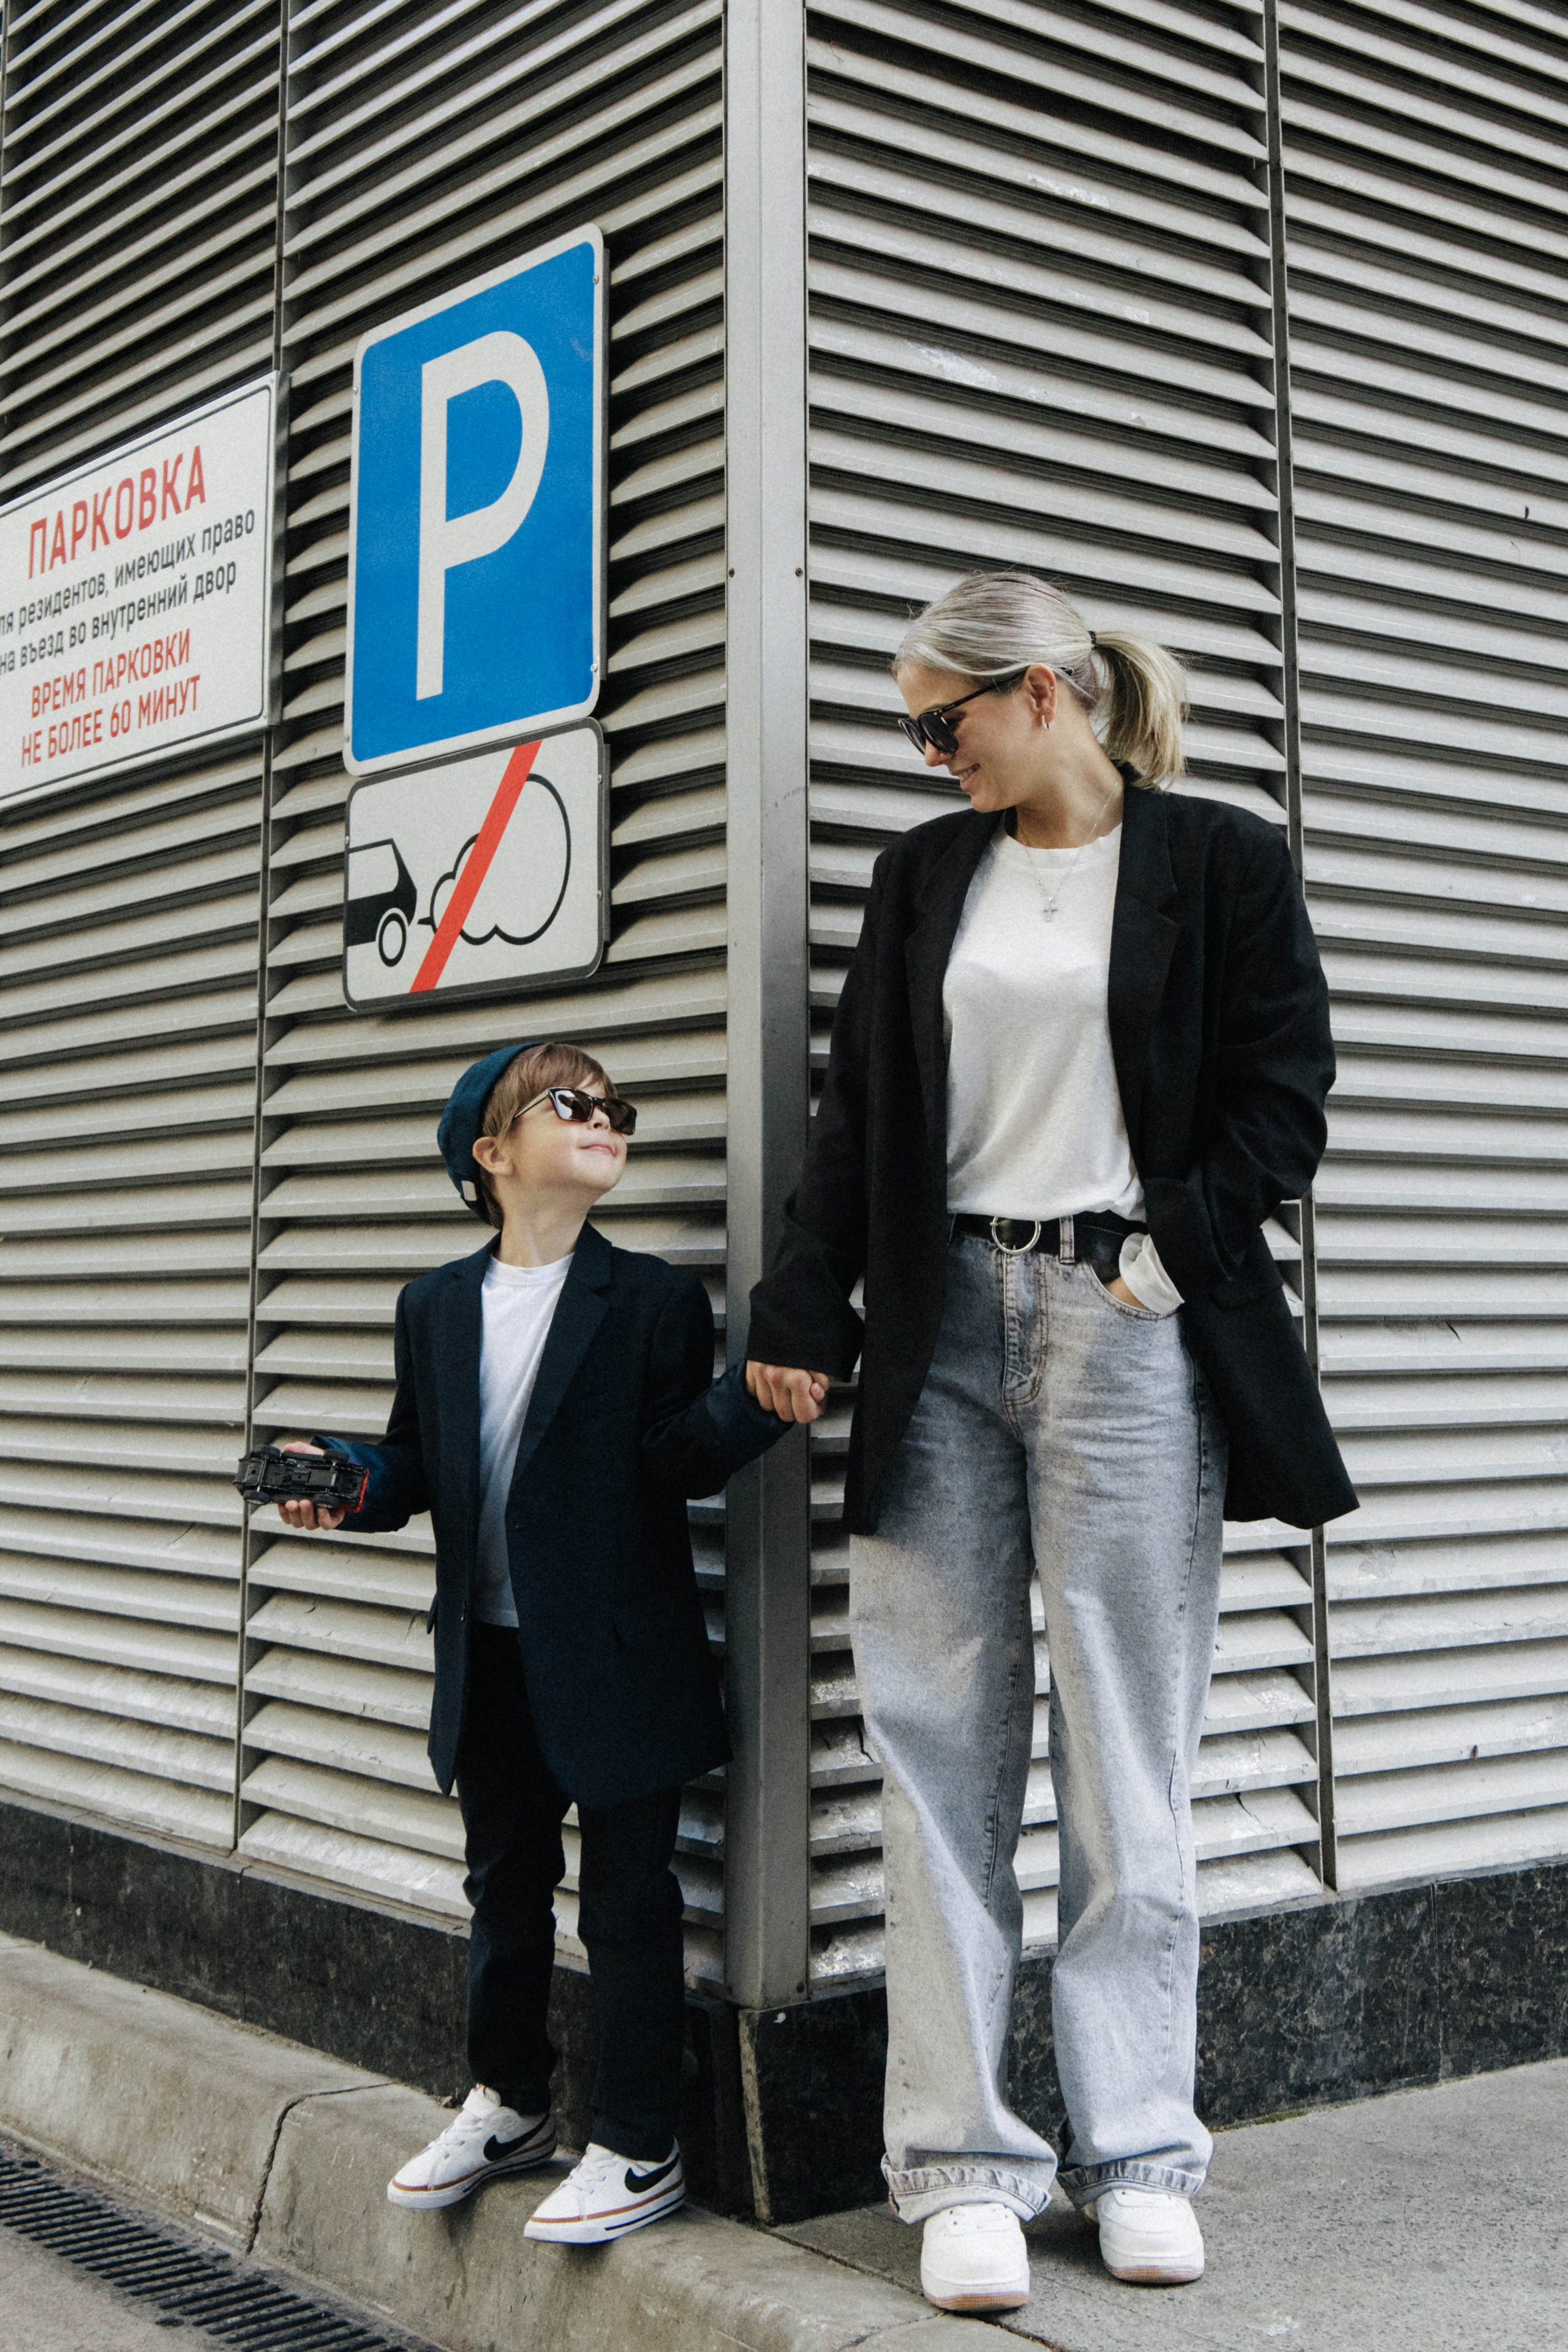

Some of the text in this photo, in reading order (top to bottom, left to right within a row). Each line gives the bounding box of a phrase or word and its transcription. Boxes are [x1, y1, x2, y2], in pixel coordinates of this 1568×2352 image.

[28, 445, 206, 579] ПАРКОВКА
[416, 331, 549, 701] P
[18, 573, 110, 635] резидентов,
[115, 533, 195, 589] имеющих
[202, 509, 255, 556] право
[20, 630, 64, 668] въезд
[69, 621, 86, 648] во
[91, 573, 187, 641] внутренний
[192, 560, 236, 604] двор
[21, 674, 200, 767] НЕ БОЛЕЕ 60 МИНУТ
[31, 628, 190, 718] ВРЕМЯ ПАРКОВКИ
